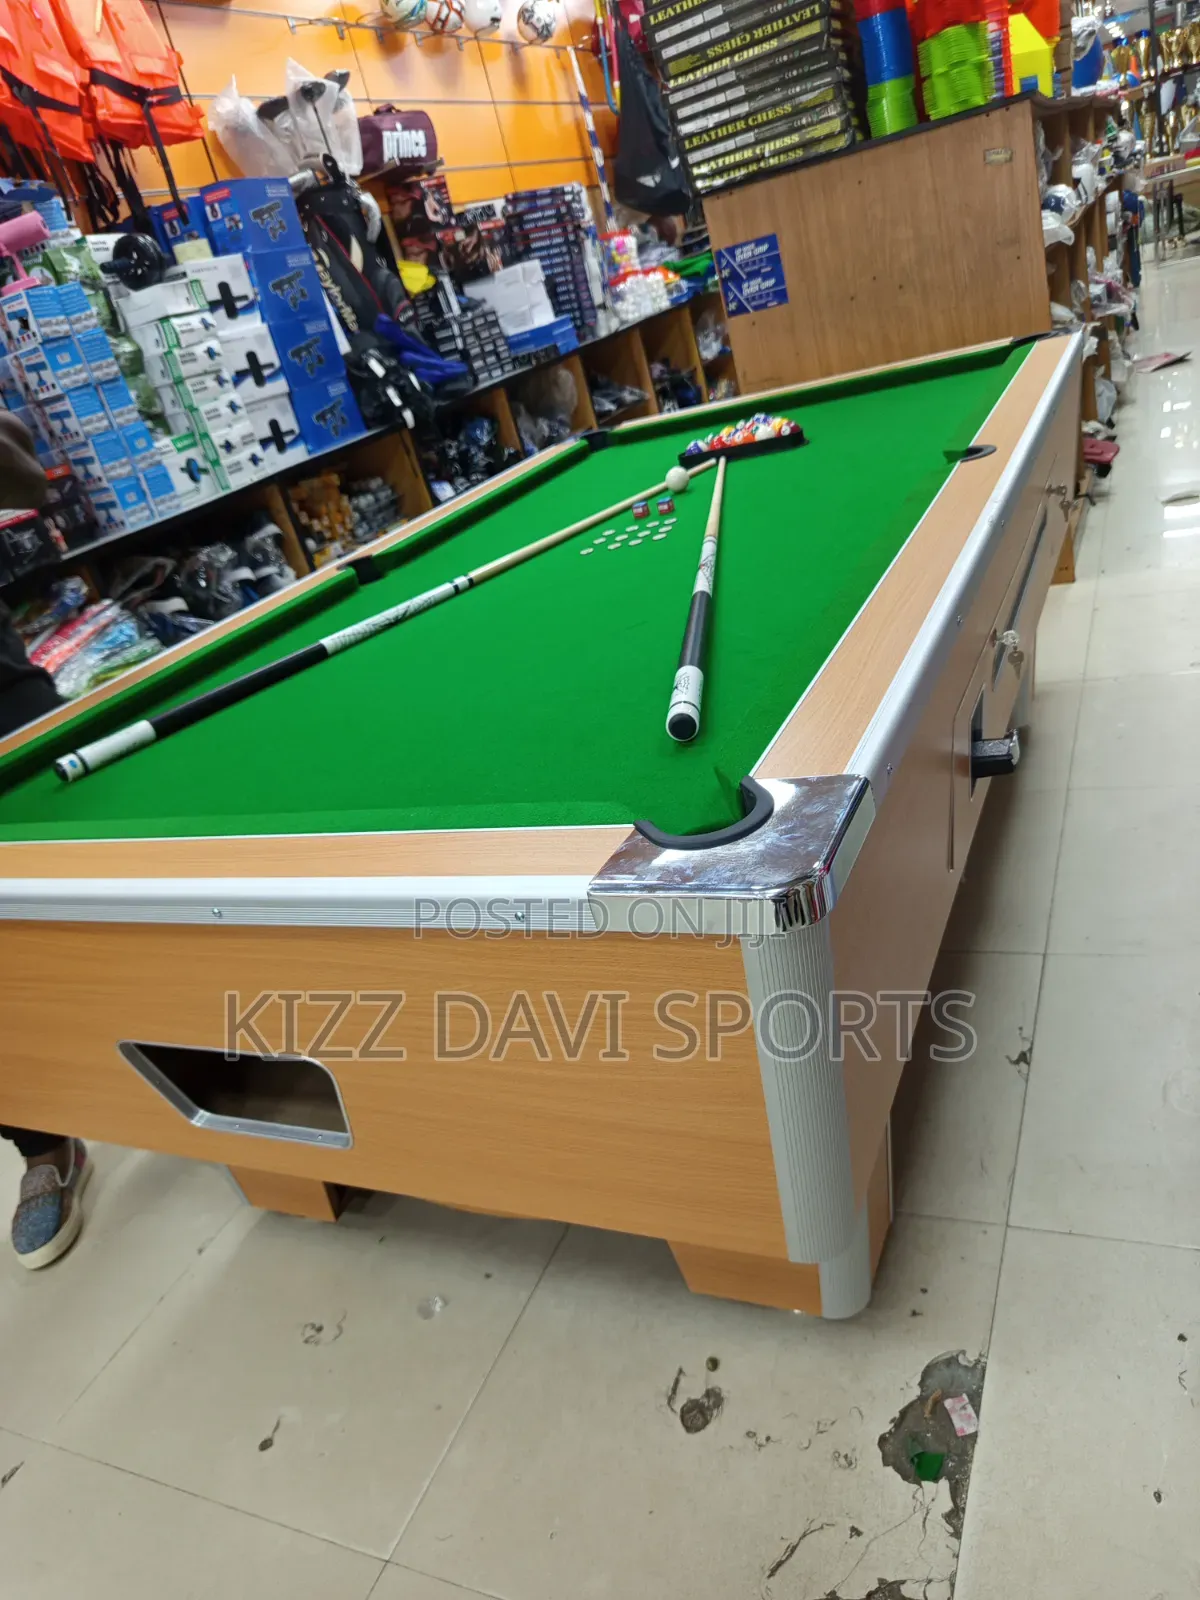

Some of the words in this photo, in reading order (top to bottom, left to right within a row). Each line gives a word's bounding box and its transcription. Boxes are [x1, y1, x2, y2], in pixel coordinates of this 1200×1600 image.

[649, 0, 708, 25] LEATH
[752, 4, 820, 39] LEATHER
[669, 57, 730, 88] LEATHER
[734, 38, 778, 62] CHESS
[706, 32, 751, 59] CHESS
[382, 122, 427, 164] prince
[684, 119, 746, 149] LEATHER
[748, 103, 792, 126] CHESS
